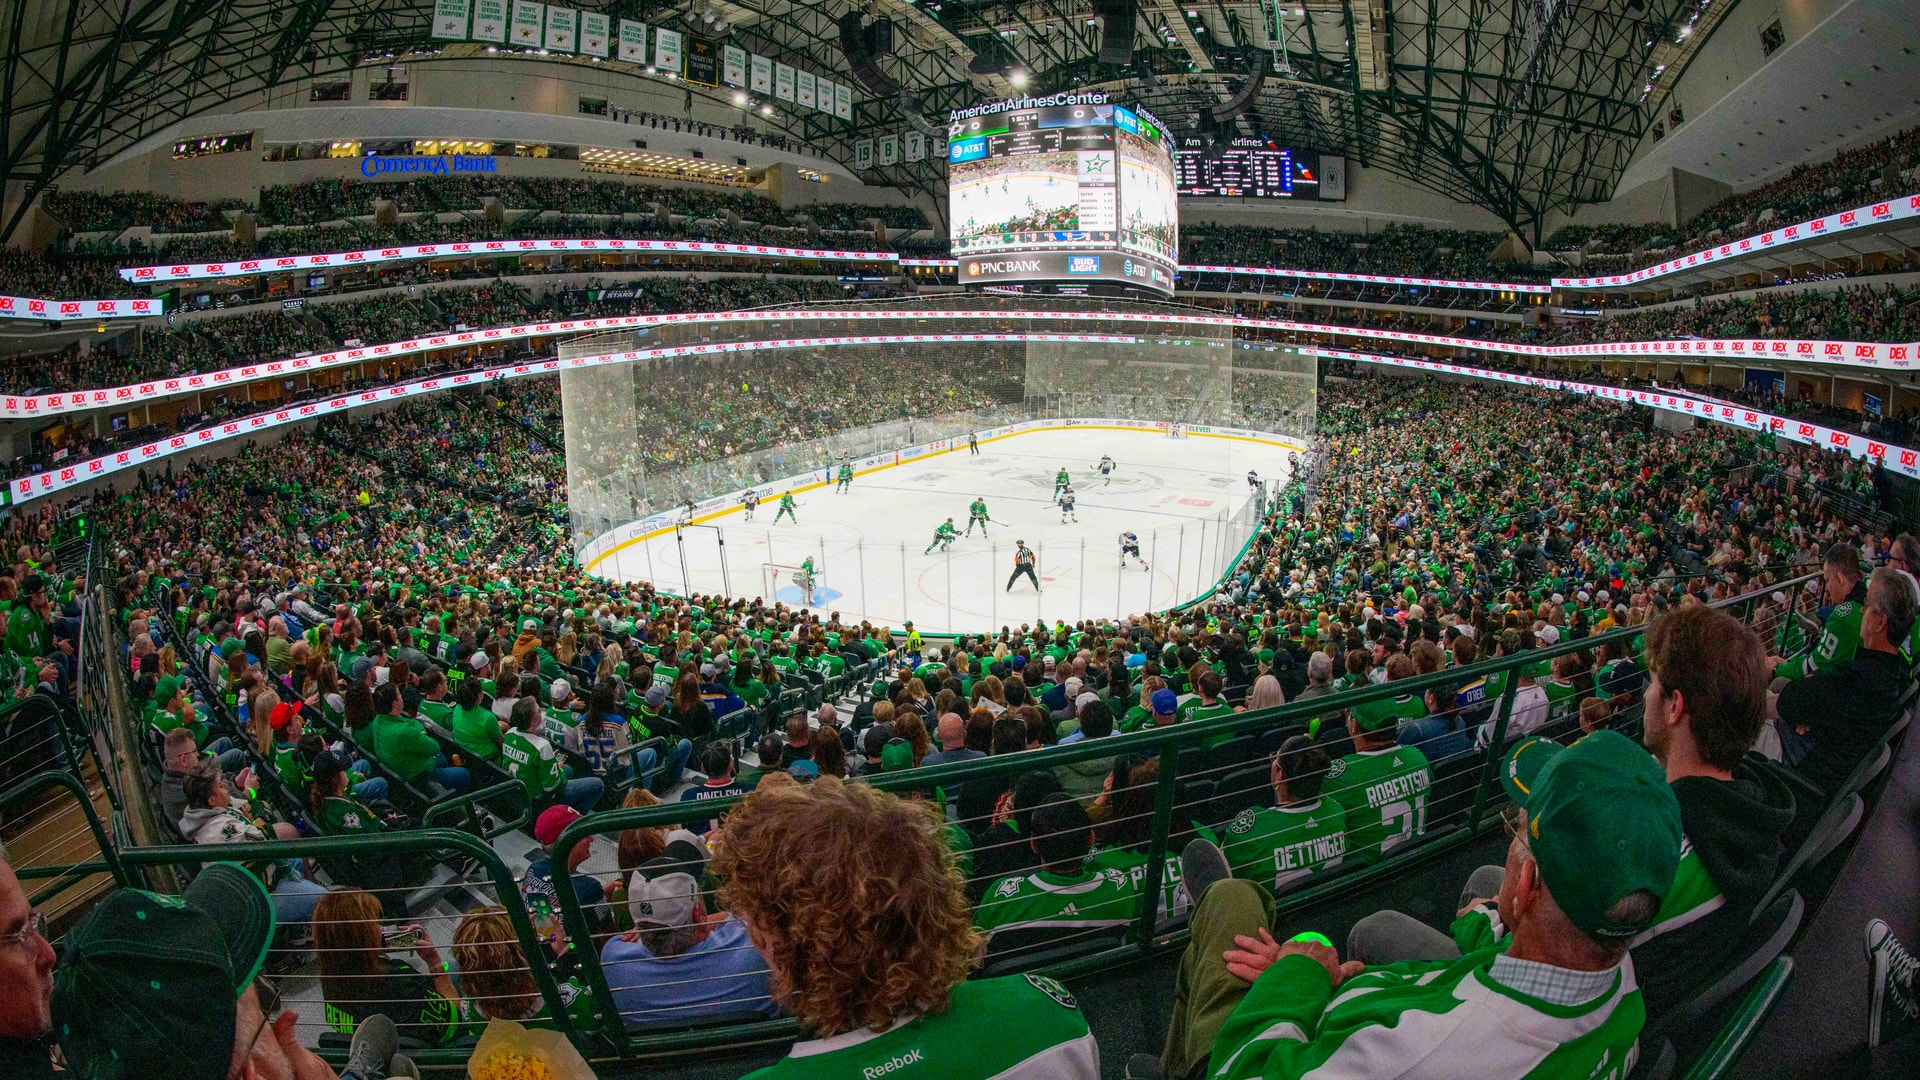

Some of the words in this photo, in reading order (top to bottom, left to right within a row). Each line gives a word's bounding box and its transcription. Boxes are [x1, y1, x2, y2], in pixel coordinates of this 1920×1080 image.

[438, 10, 465, 18] CHAMPIONS
[482, 6, 500, 14] DIVISION
[521, 5, 537, 13] PACIFIC
[478, 13, 502, 21] CHAMPIONS
[515, 18, 539, 26] CHAMPIONS
[549, 24, 572, 32] CHAMPIONS
[584, 29, 606, 38] CHAMPIONS
[1011, 114, 1038, 123] 15:14
[1074, 110, 1085, 118] 0
[1123, 115, 1137, 128] AT&T
[885, 142, 892, 157] 8
[911, 139, 919, 153] 7
[963, 142, 985, 154] AT&T
[858, 147, 870, 161] 19
[453, 155, 498, 172] Bank
[1872, 204, 1890, 216] DEX
[1840, 212, 1856, 224] DEX
[1877, 213, 1893, 221] imaging
[1811, 220, 1825, 230] DEX
[240, 262, 259, 270] DEX
[277, 258, 295, 266] DEX
[1073, 257, 1093, 265] BUD
[136, 268, 154, 277] DEX
[171, 266, 189, 274] DEX
[1070, 264, 1098, 272] LIGHT
[1132, 265, 1147, 277] AT&T
[607, 291, 634, 299] STARS
[28, 300, 45, 312] DEX
[60, 303, 81, 313] DEX
[97, 302, 115, 311] DEX
[132, 301, 149, 310] DEX
[1752, 342, 1767, 351] DEX
[1772, 342, 1788, 352] DEX
[1797, 342, 1815, 353] DEX
[1824, 343, 1844, 355] DEX
[1855, 345, 1877, 358] DEX
[320, 354, 337, 362] DEX
[1889, 346, 1909, 360] DEX
[292, 359, 309, 367] DEX
[1860, 357, 1877, 365] imaging
[214, 372, 230, 381] DEX
[140, 384, 155, 394] DEX
[165, 380, 180, 389] DEX
[116, 388, 133, 398] DEX
[47, 396, 63, 407] DEX
[72, 393, 86, 404] DEX
[5, 398, 18, 410] DEX
[24, 398, 38, 410] DEX
[1744, 412, 1759, 422] DEX
[222, 422, 238, 432] DEX
[1770, 418, 1785, 429] DEX
[1798, 424, 1816, 437] DEX
[1830, 432, 1851, 446] DEX
[142, 445, 157, 456] DEX
[1868, 442, 1887, 457] DEX
[1900, 450, 1918, 466] DEX
[89, 460, 103, 472] DEX
[61, 468, 75, 481] DEX
[19, 480, 31, 493] DEX
[550, 763, 558, 776] 4
[1365, 767, 1430, 809] ROBERTSON
[1273, 830, 1347, 871] OETTINGER
[325, 1003, 354, 1035] BENN
[863, 1049, 924, 1080] Reebok
